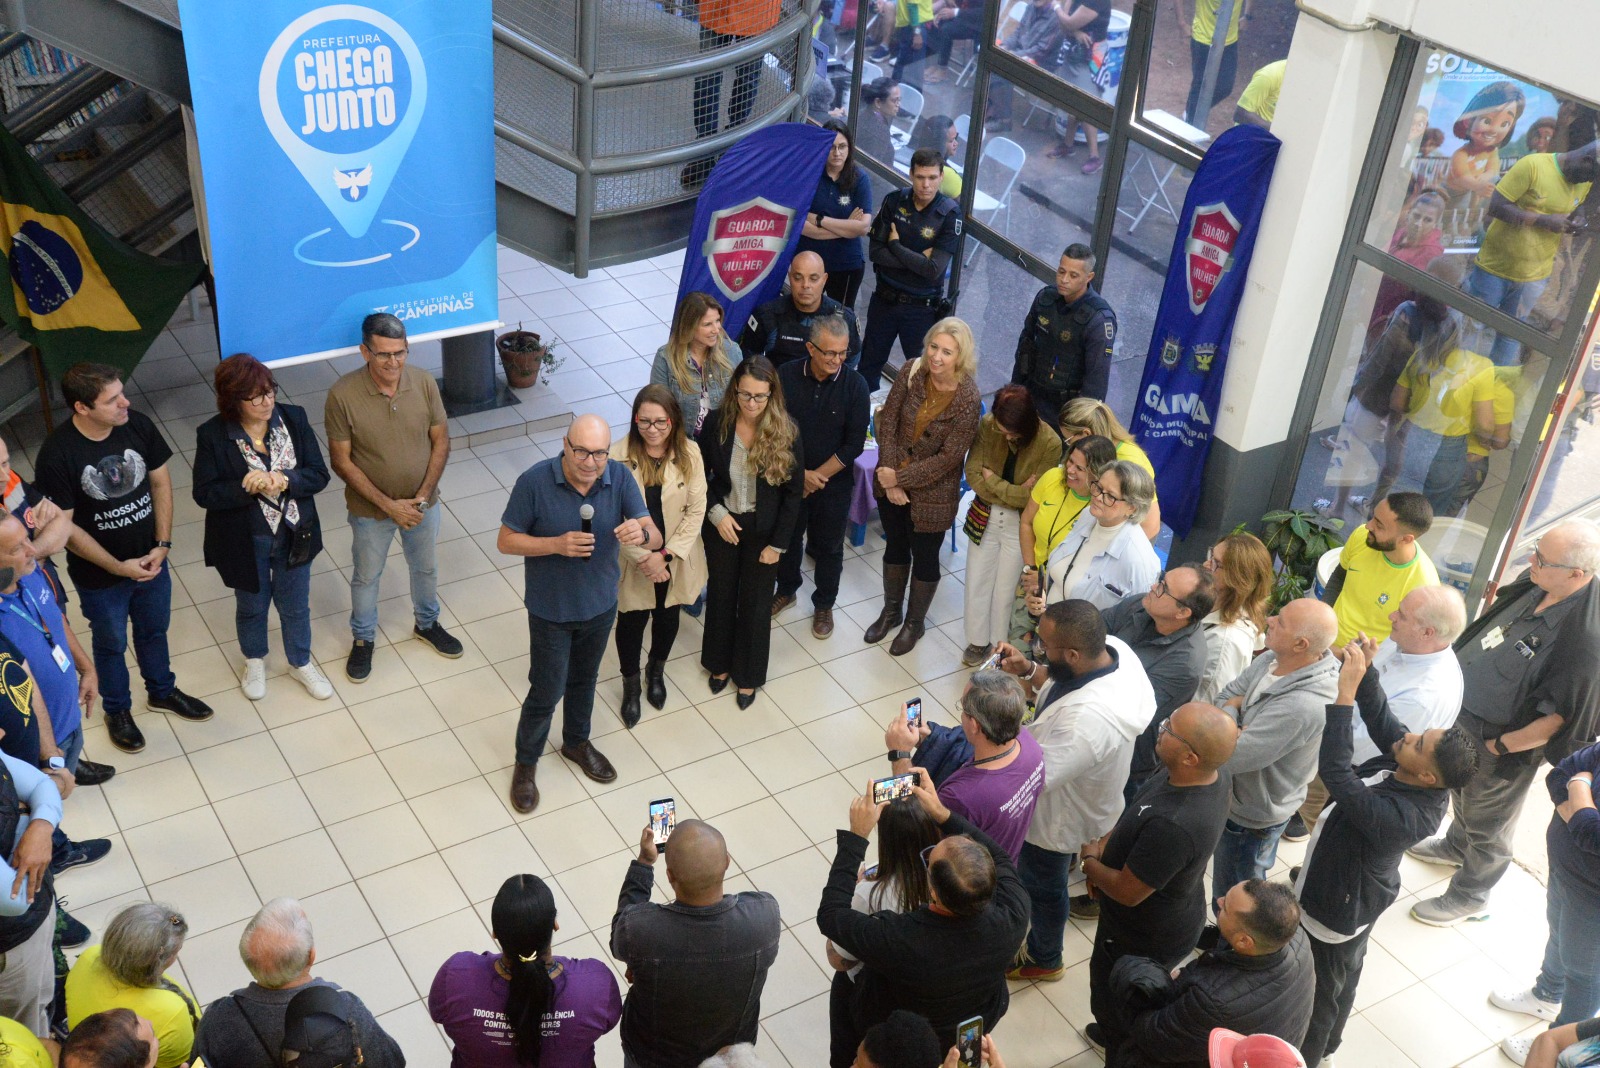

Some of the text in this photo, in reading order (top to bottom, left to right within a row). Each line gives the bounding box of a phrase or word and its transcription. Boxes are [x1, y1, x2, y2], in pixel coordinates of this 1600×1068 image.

[303, 34, 381, 49] PREFEITURA
[294, 45, 394, 92] CHEGA
[301, 86, 396, 135] JUNTO
[727, 219, 775, 233] GUARDA
[1201, 222, 1230, 245] GUARDA
[732, 238, 764, 250] AMIGA
[1200, 245, 1220, 262] AMIGA
[722, 260, 763, 272] MULHER
[393, 291, 474, 310] PREFEITURA DE
[394, 298, 475, 321] CAMPINAS
[94, 513, 103, 521] A
[103, 502, 138, 519] NOSSA
[97, 503, 152, 530] SALVA VIDAS
[473, 1008, 494, 1019] TODOS
[484, 1019, 512, 1030] CONTRA
